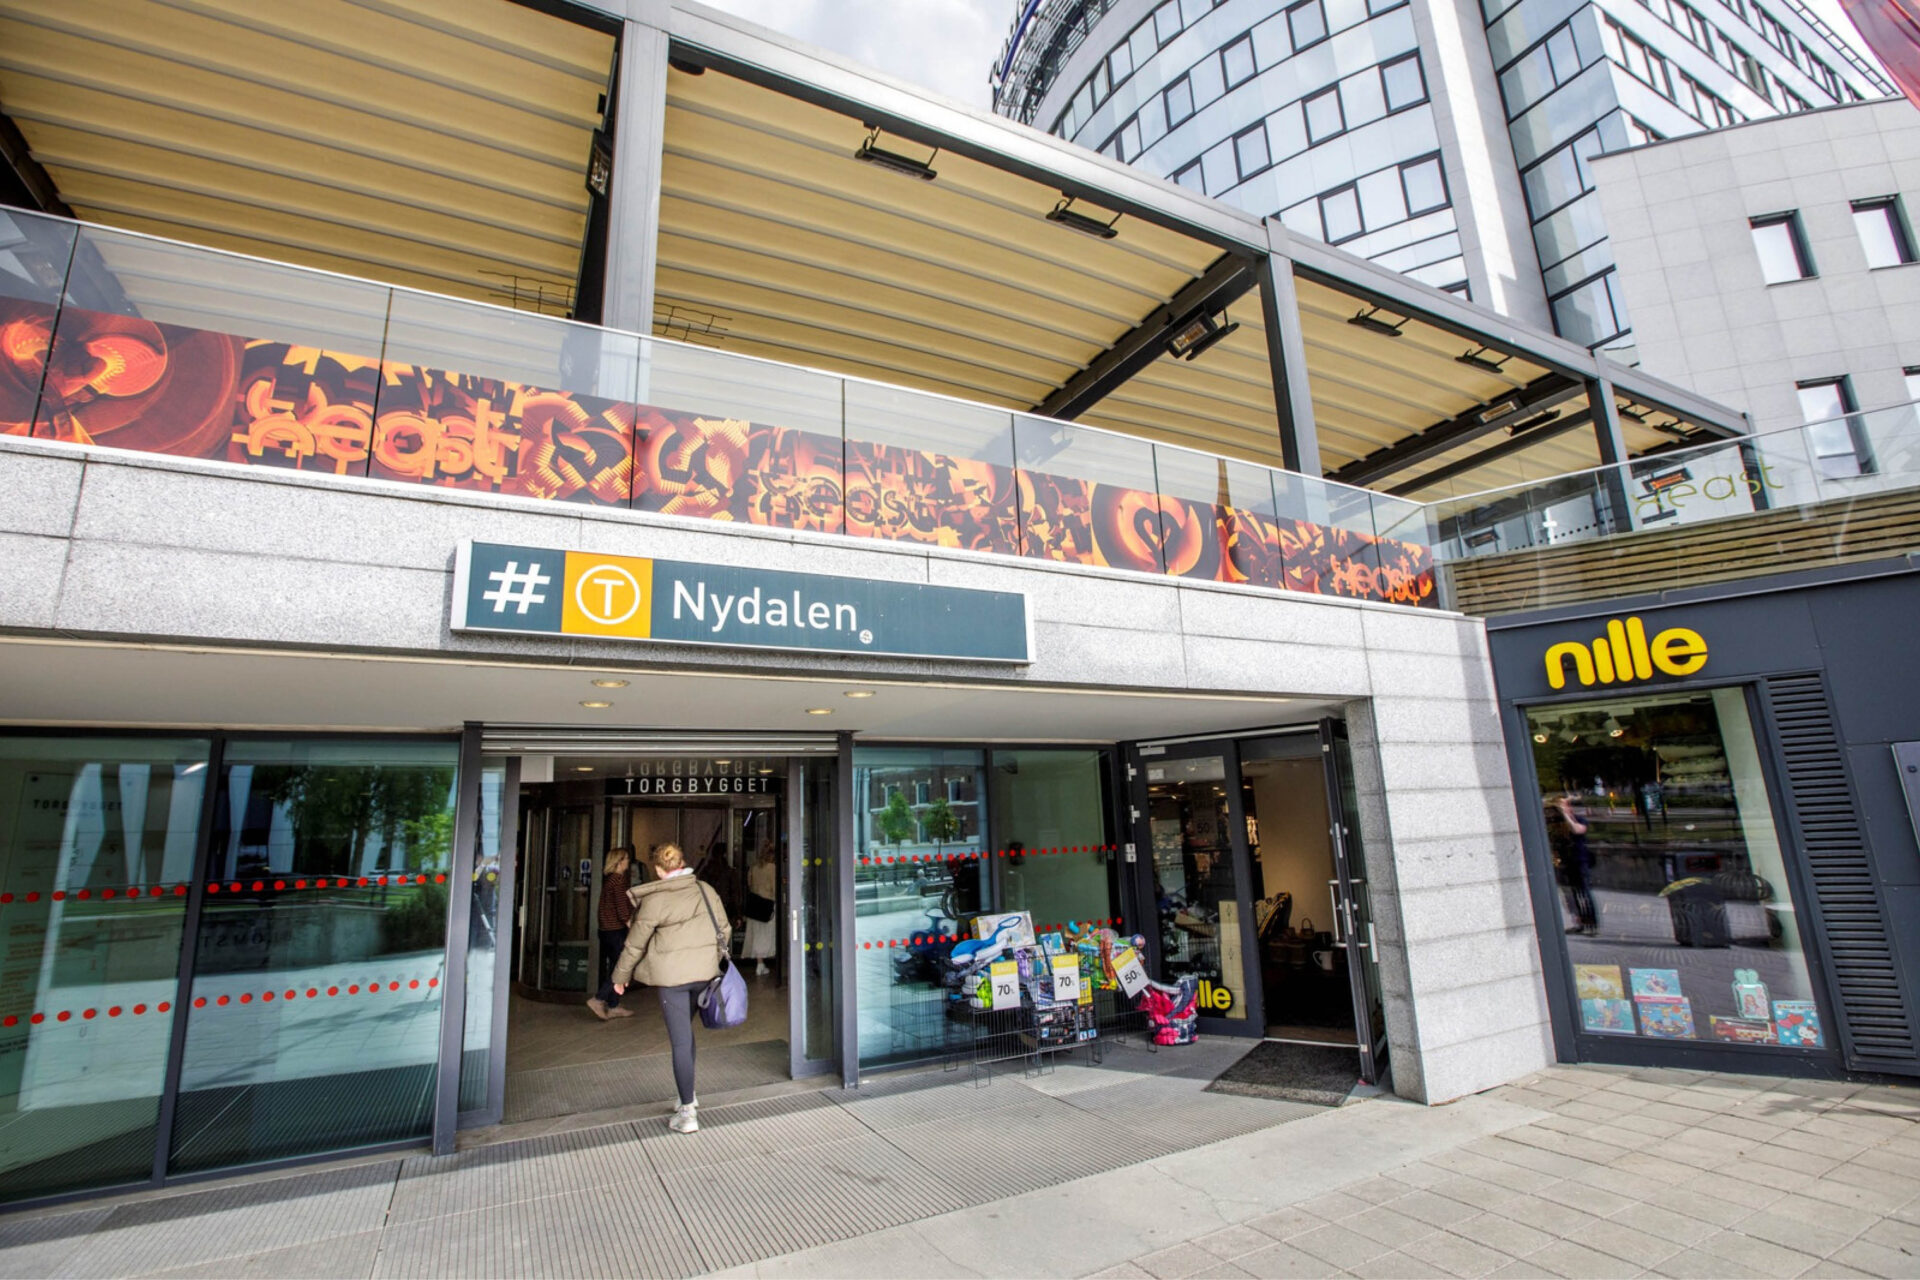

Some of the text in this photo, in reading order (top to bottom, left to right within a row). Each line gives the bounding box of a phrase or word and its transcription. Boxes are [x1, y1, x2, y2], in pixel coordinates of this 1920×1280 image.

[673, 579, 858, 633] Nydalen
[1545, 616, 1708, 689] nille
[625, 778, 768, 793] TORGBYGGET
